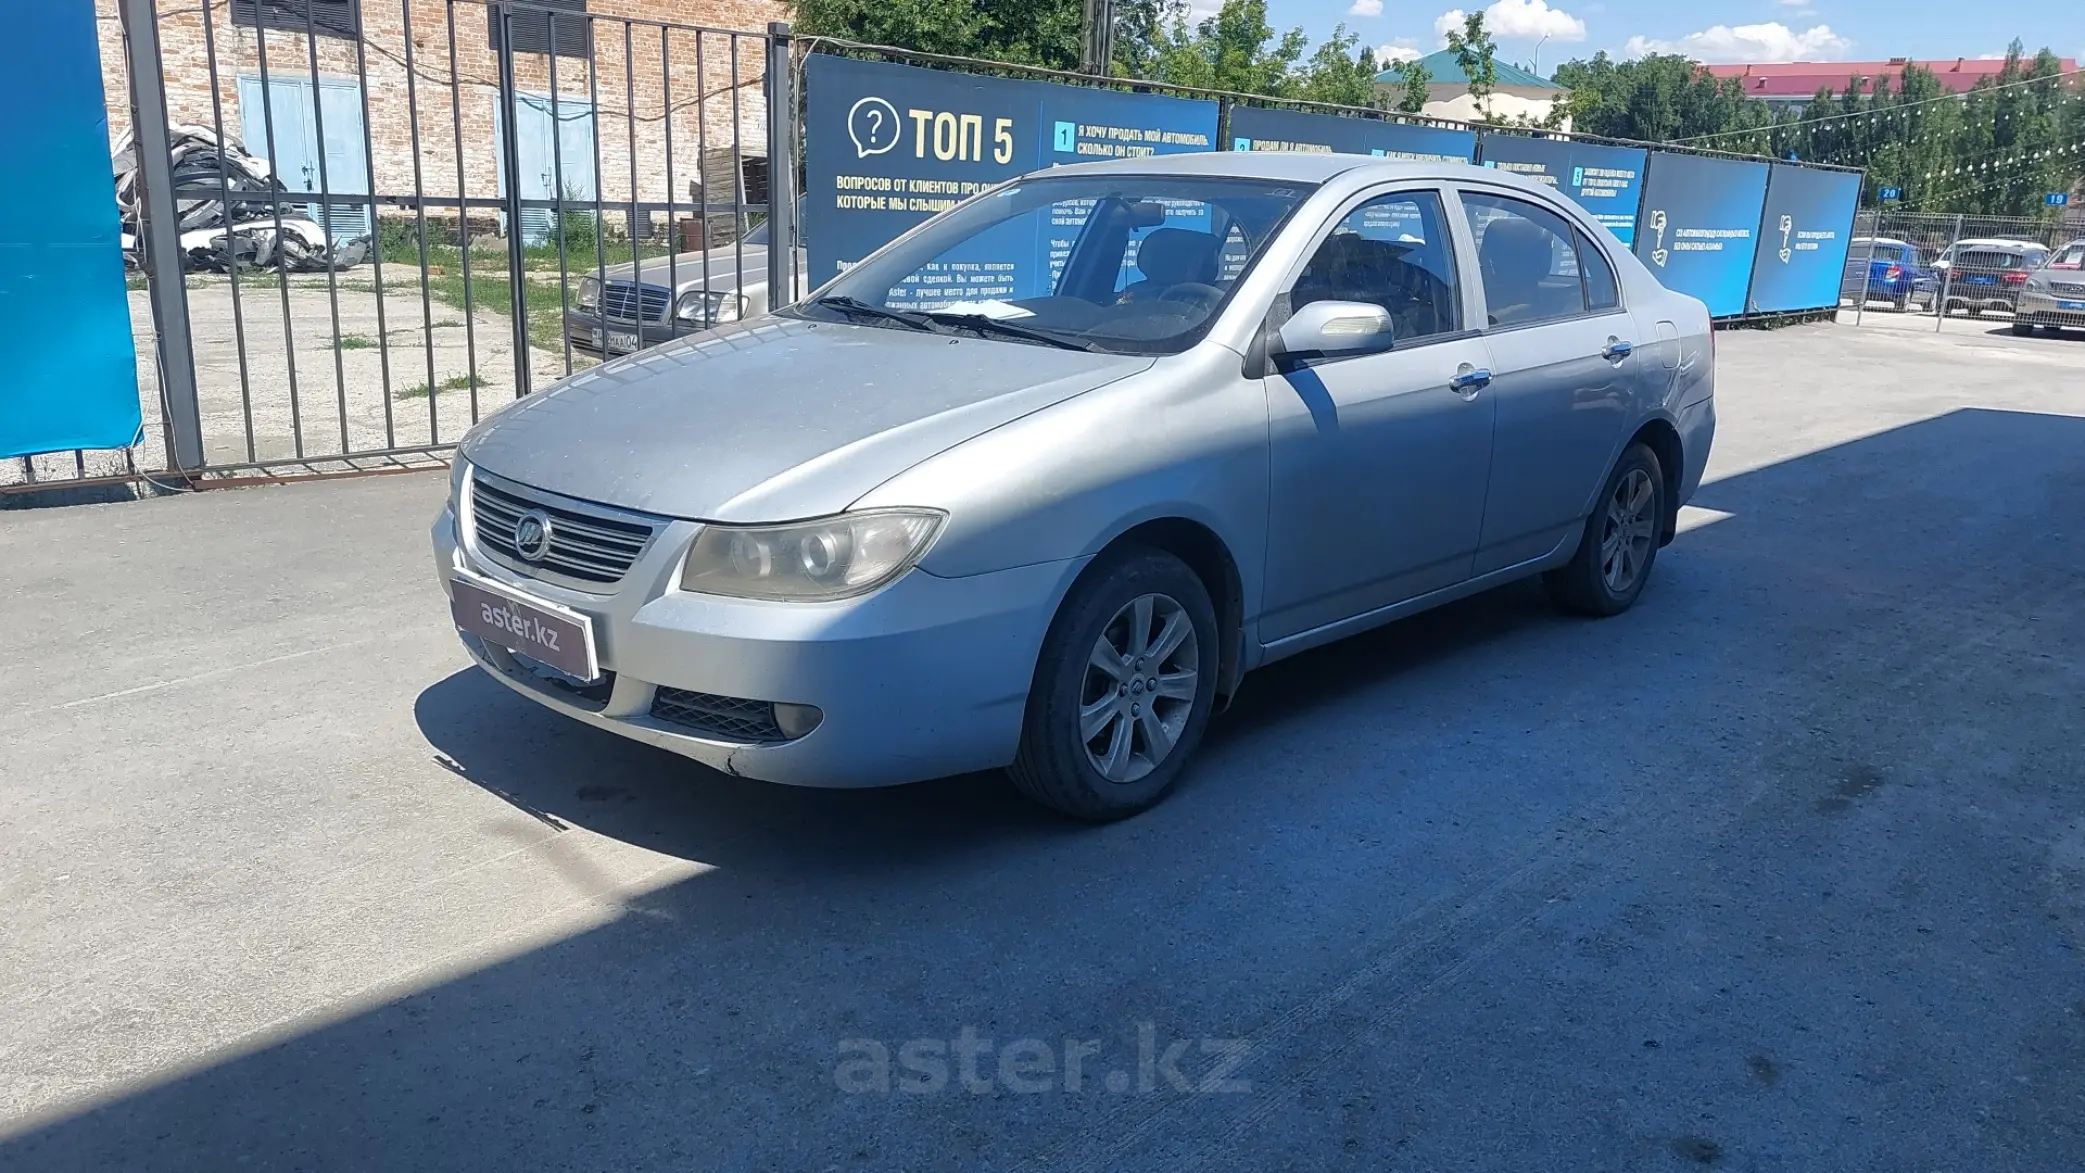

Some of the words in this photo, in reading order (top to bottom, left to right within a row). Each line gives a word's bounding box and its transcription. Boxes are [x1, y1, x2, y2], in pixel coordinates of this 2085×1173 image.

[908, 109, 983, 162] ТОП
[993, 118, 1013, 165] 5
[1078, 125, 1085, 137] Я
[1086, 125, 1107, 139] ХОЧУ
[1108, 127, 1143, 142] ПРОДАТЬ
[1144, 129, 1161, 142] МОЙ
[1077, 143, 1113, 156] СКОЛЬКО
[1114, 145, 1126, 157] ОН
[836, 175, 891, 191] ВОПРОСОВ
[893, 178, 908, 191] ОТ
[909, 179, 959, 194] КЛИЕНТОВ
[960, 182, 980, 196] ПРО
[1883, 188, 1896, 199] 20
[2049, 193, 2063, 204] 19
[836, 195, 887, 209] КОТОРЫЕ
[888, 197, 907, 210] МЫ
[909, 198, 955, 212] СЛЫШИМ
[927, 263, 940, 271] как
[951, 263, 981, 273] покупка,
[984, 263, 1015, 272] является
[923, 274, 953, 284] сделкой.
[956, 275, 967, 283] Вы
[970, 275, 995, 283] можете
[998, 273, 1014, 283] быть
[889, 288, 907, 297] Aster
[915, 288, 941, 298] лучшее
[944, 288, 963, 296] место
[965, 287, 978, 296] для
[480, 602, 561, 652] aster.kz
